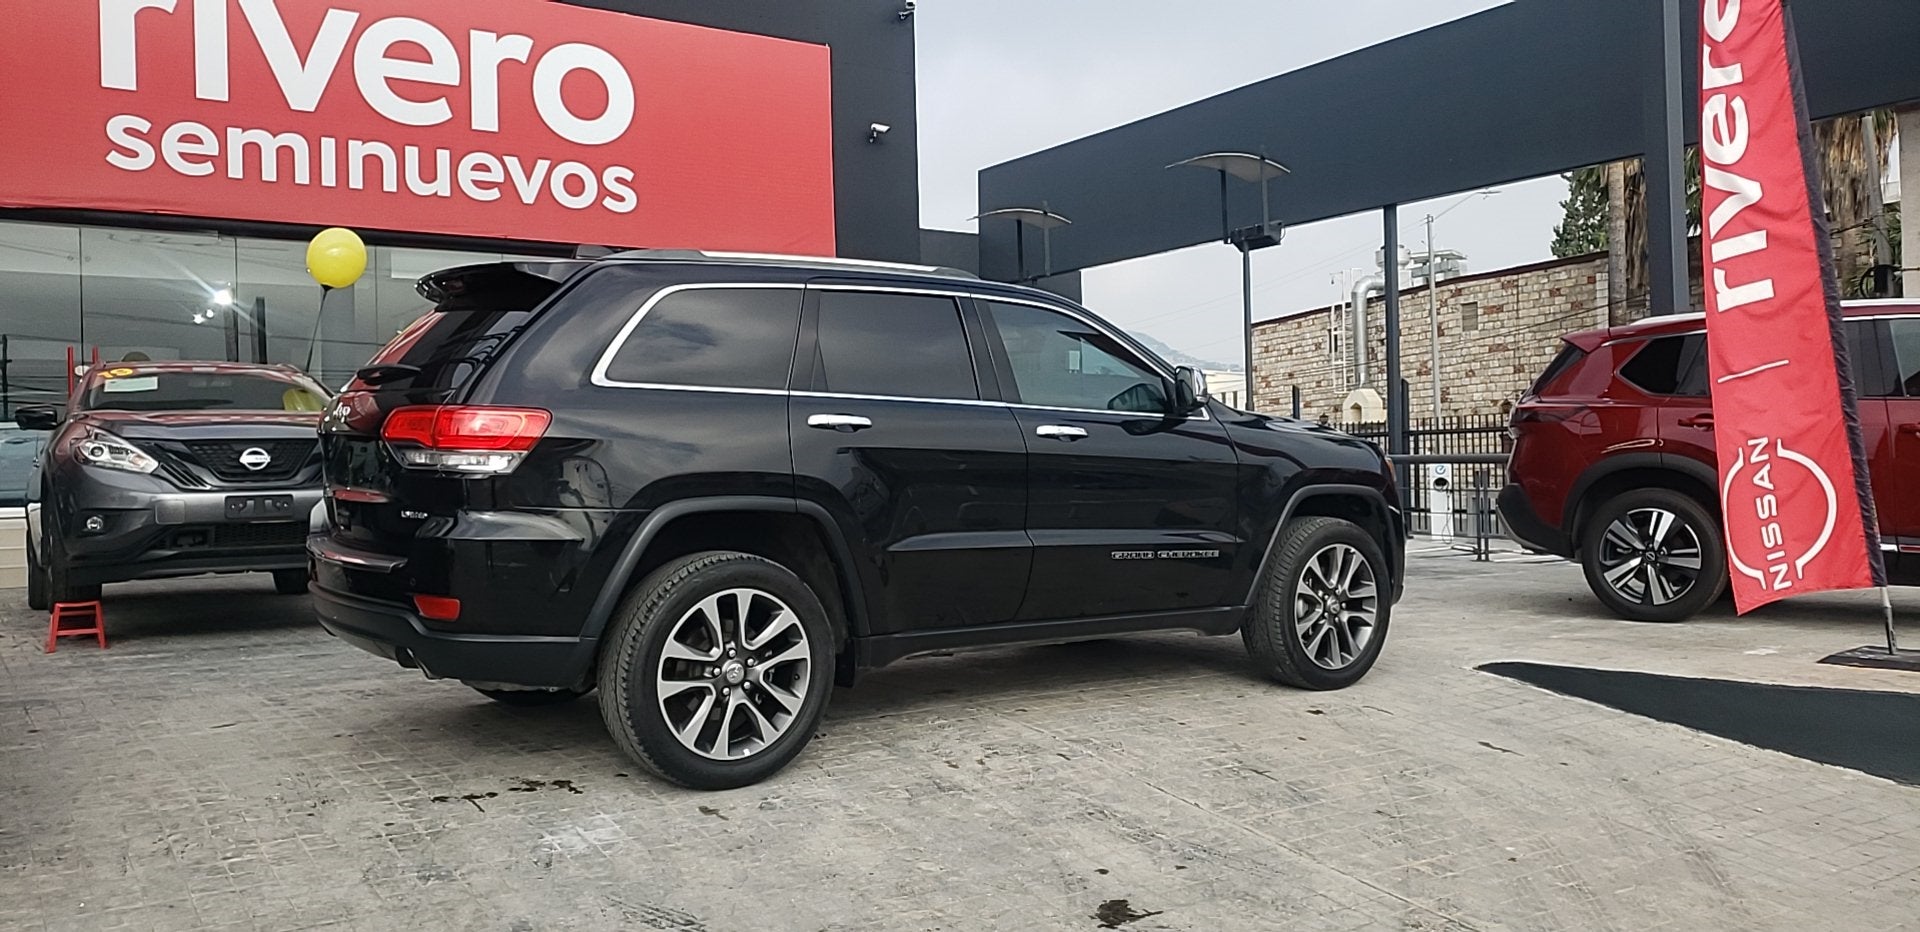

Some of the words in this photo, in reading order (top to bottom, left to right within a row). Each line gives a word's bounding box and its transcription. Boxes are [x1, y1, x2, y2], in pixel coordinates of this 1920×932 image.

[99, 0, 635, 146] rivero
[105, 114, 638, 214] seminuevos
[1747, 436, 1793, 592] NISSAN
